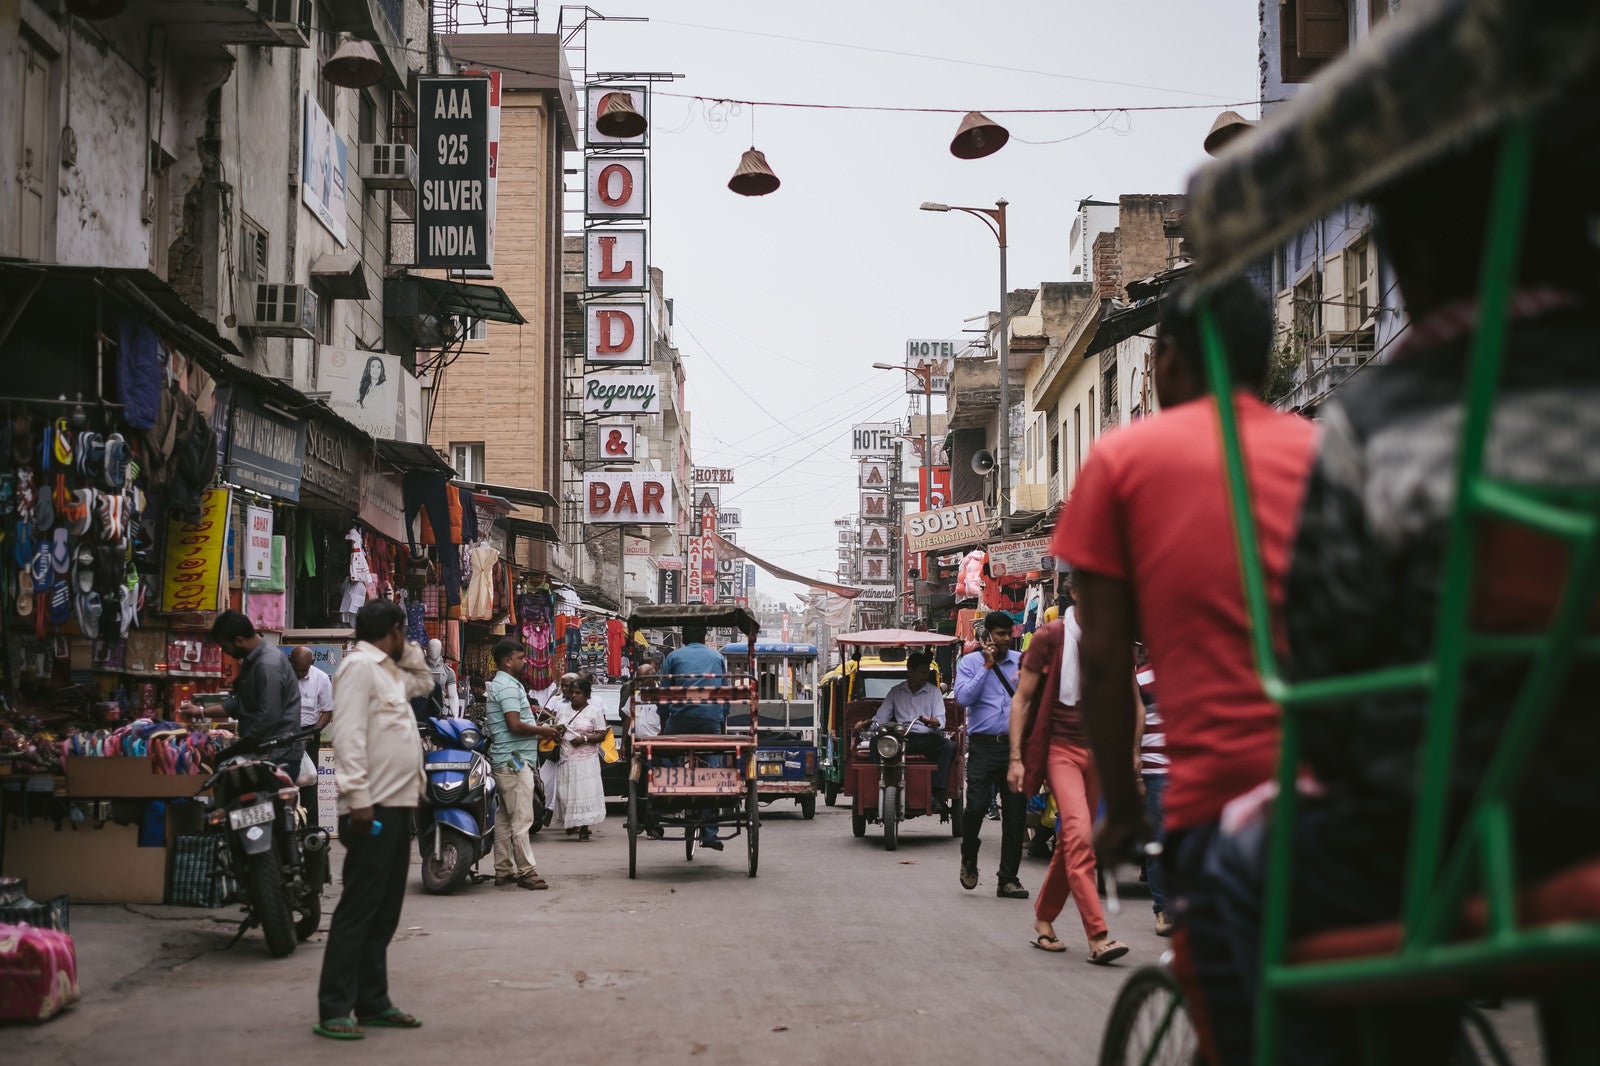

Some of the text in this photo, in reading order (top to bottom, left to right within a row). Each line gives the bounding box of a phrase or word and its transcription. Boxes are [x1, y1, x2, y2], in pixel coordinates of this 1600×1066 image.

[434, 88, 472, 119] AAA
[437, 134, 469, 165] 925
[423, 180, 482, 211] SILVER
[596, 92, 635, 354] OLD
[429, 226, 476, 256] INDIA
[586, 379, 656, 409] Regency
[605, 429, 628, 455] &
[854, 430, 894, 449] HOTEL
[695, 469, 734, 482] HOTEL
[589, 481, 664, 514] BAR
[703, 507, 714, 559] KIRAN
[866, 466, 884, 576] AMAN
[908, 504, 982, 538] SOBTI
[912, 526, 983, 549] INTERNATIONAL
[990, 542, 1021, 554] COMFORT
[689, 538, 700, 594] KAILASH
[859, 587, 895, 599] ontinental
